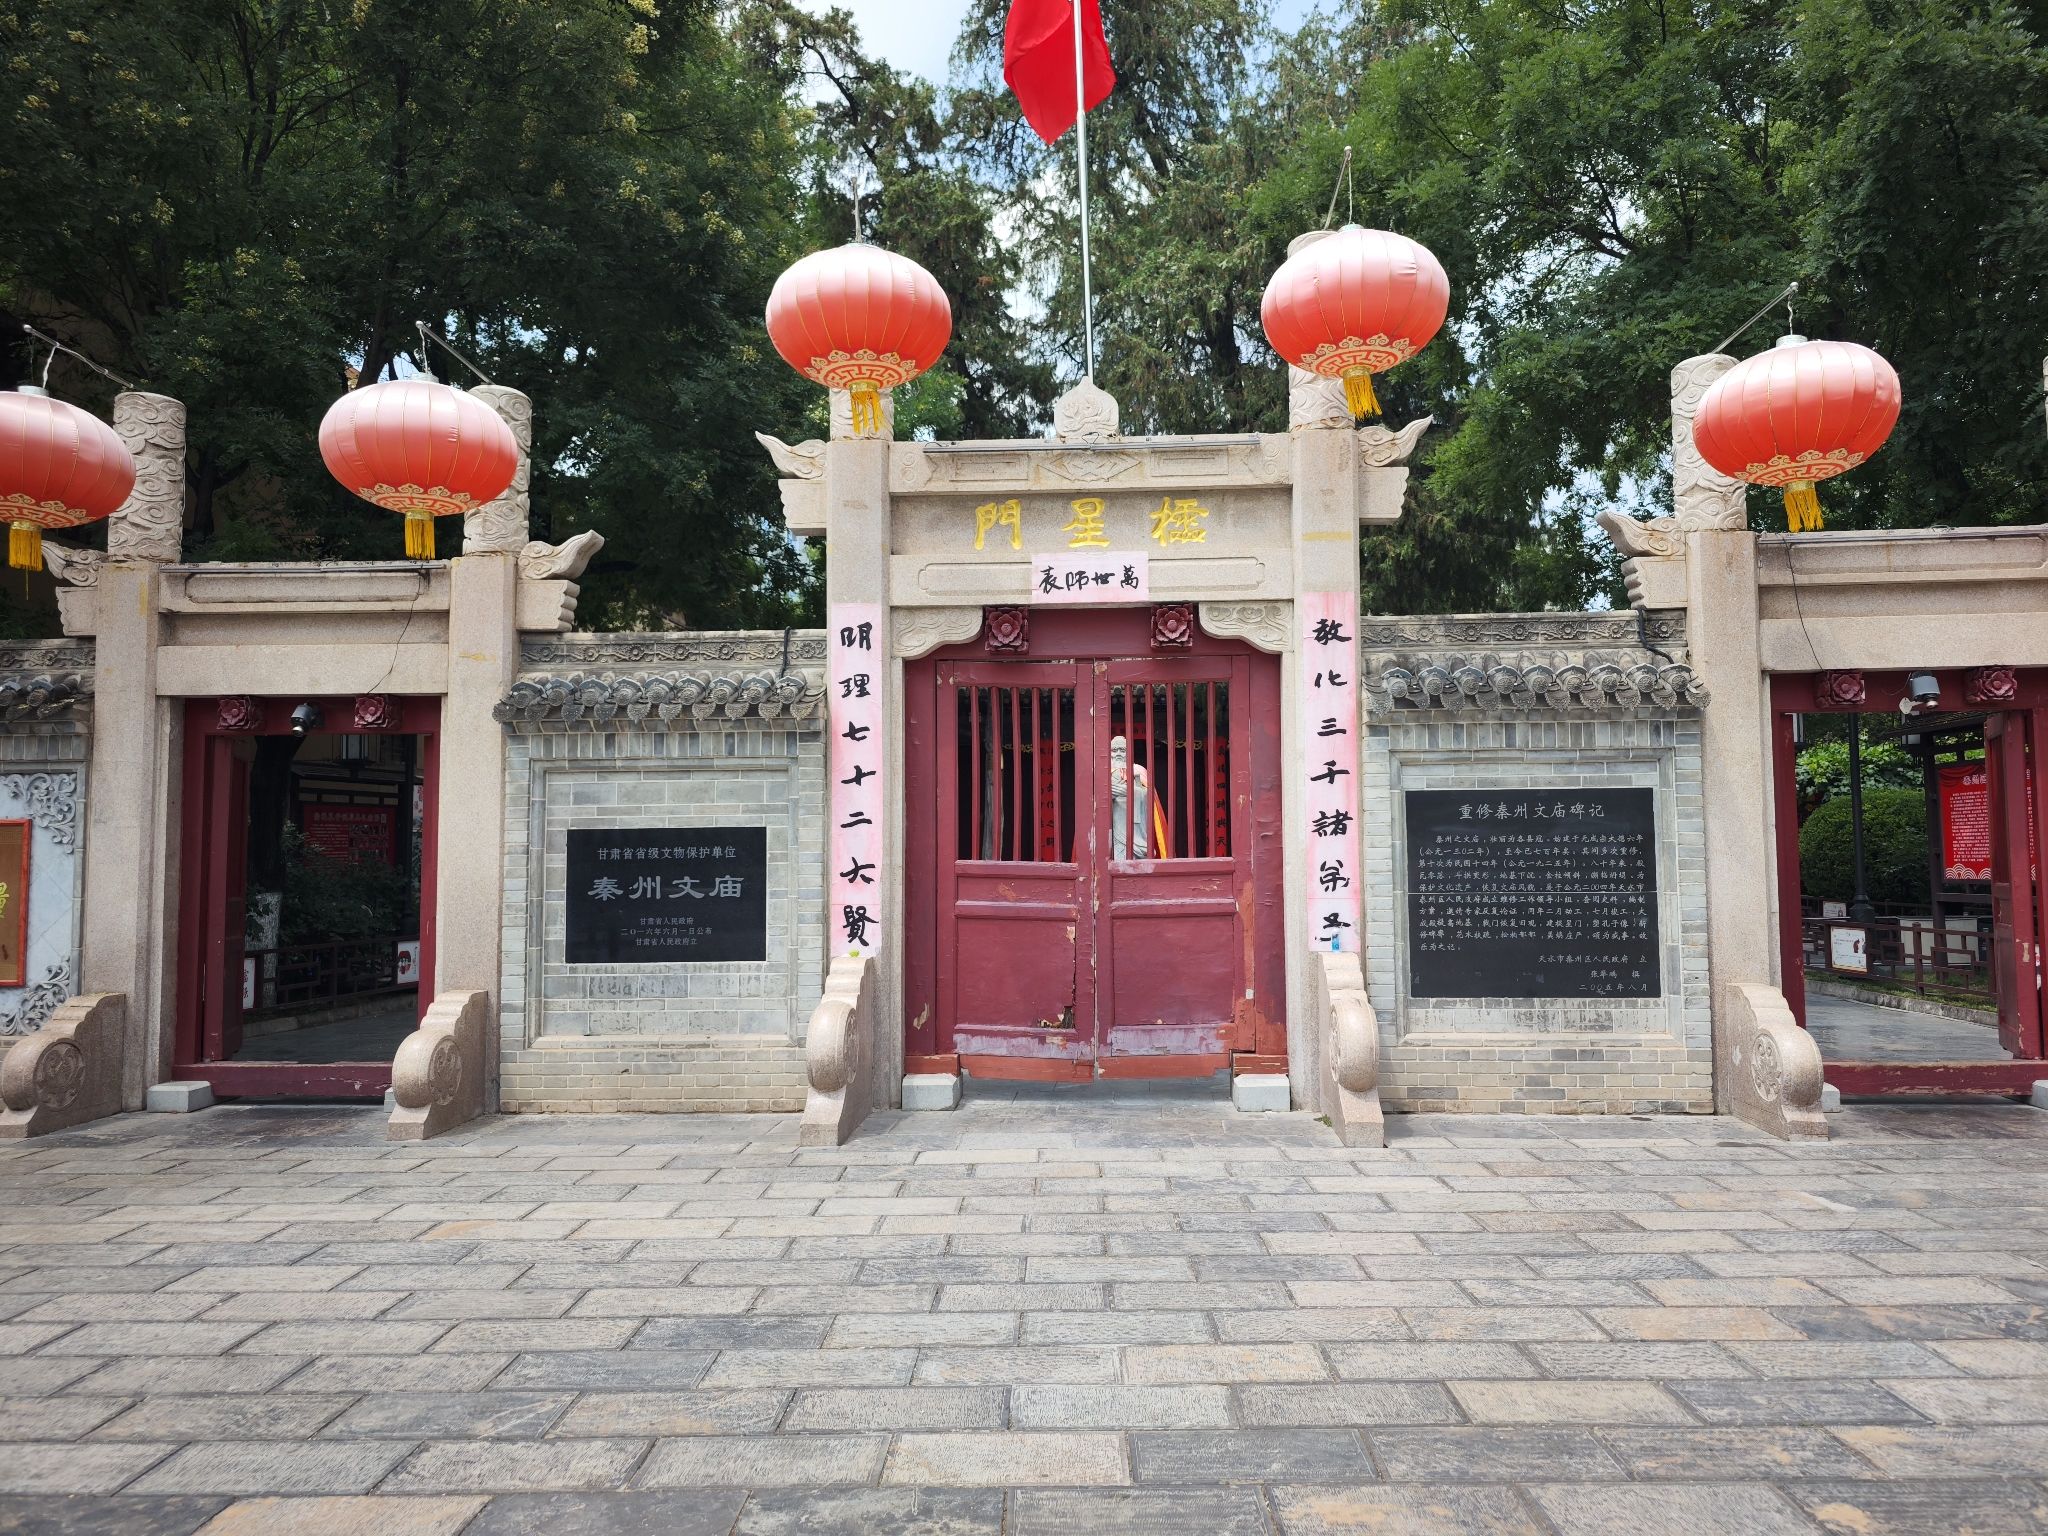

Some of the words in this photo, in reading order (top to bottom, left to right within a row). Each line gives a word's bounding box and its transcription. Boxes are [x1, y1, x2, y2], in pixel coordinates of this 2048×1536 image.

[1458, 802, 1605, 820] 重修秦州文庙碑记
[597, 846, 737, 861] 甘肃省省级文物保护单位
[587, 875, 745, 901] 秦州文庙
[639, 917, 695, 926] 甘肃省人民政府
[635, 937, 698, 946] 甘肃省人民政府立
